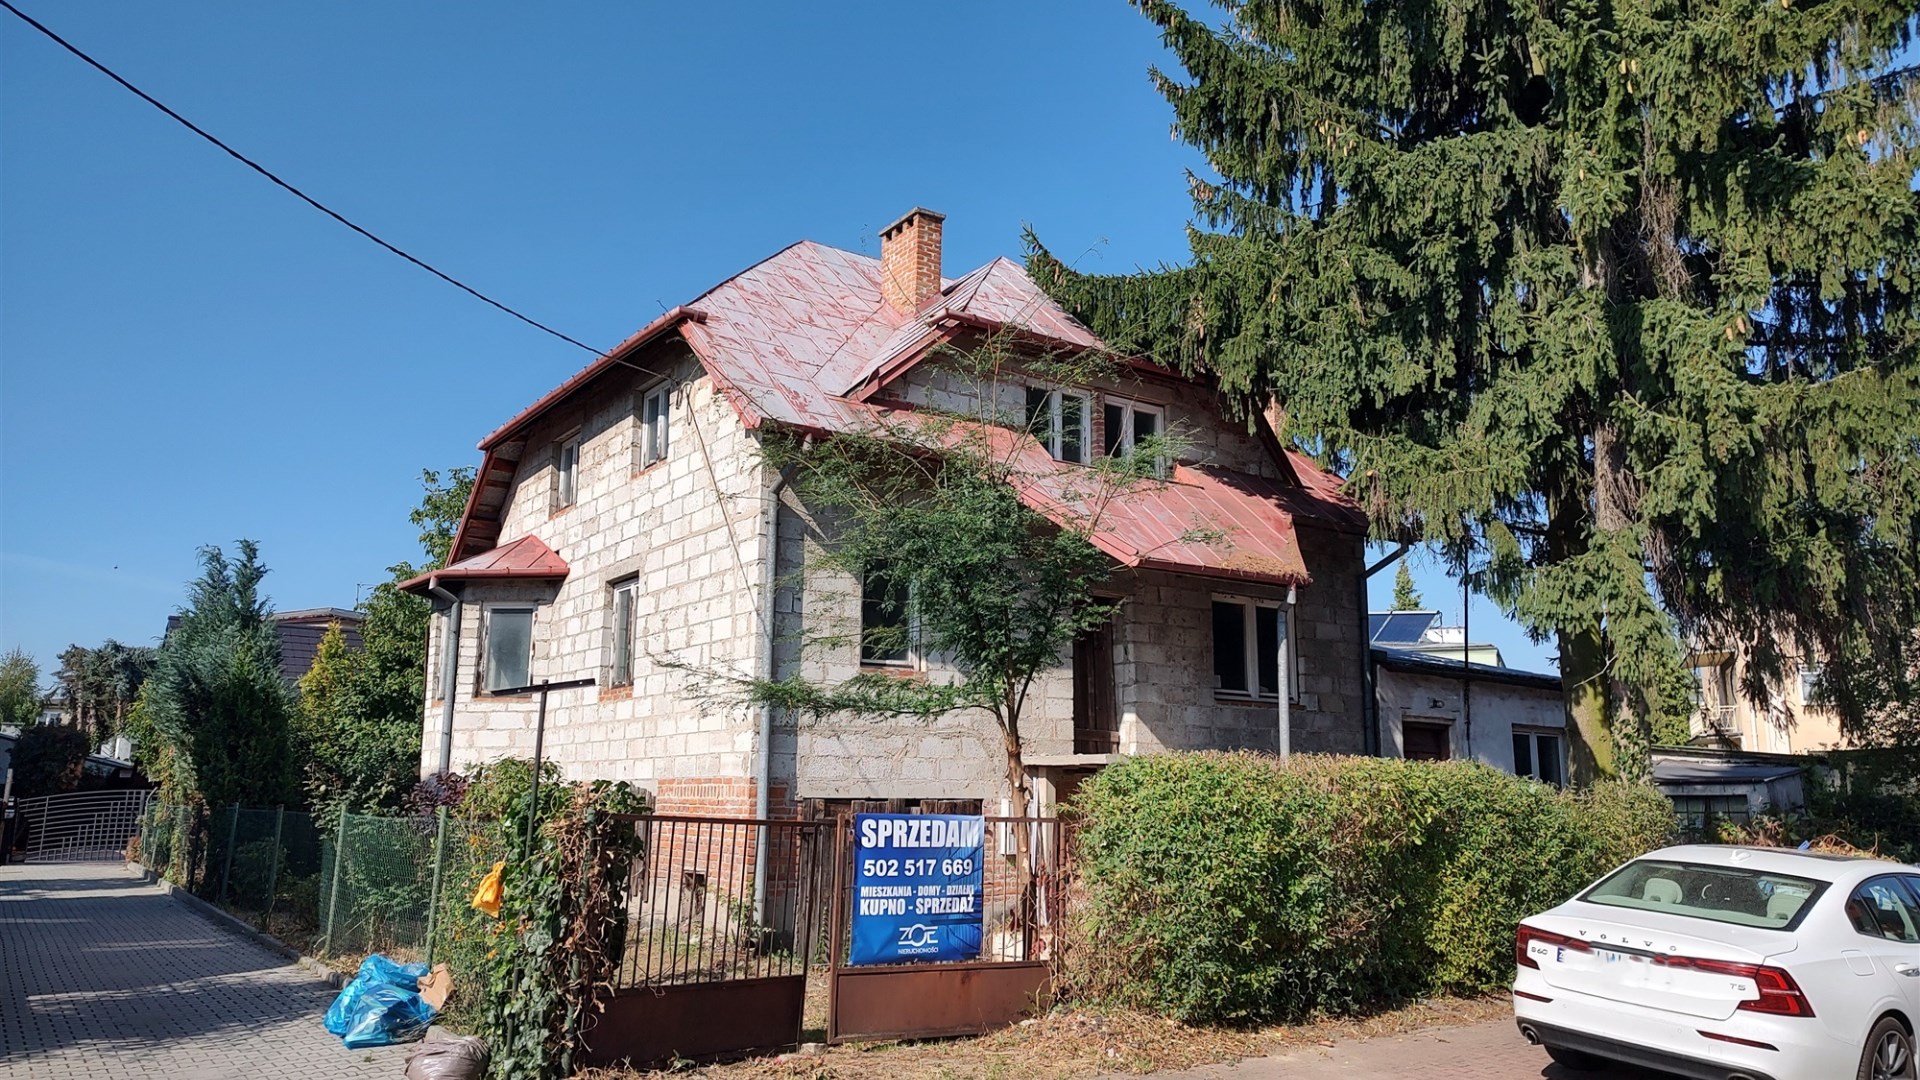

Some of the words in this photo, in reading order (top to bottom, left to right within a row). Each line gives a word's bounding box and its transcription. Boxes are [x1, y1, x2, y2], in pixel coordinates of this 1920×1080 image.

[861, 819, 979, 848] SPRZEDAM
[863, 859, 898, 877] 502
[904, 859, 936, 876] 517
[942, 859, 973, 875] 669
[860, 886, 912, 897] MIESZKANIA
[918, 886, 941, 896] DOMY
[860, 898, 906, 916] KUPNO
[916, 894, 974, 915] SPRZEDAŻ
[1531, 946, 1548, 956] S60
[1579, 930, 1677, 952] VOLVO
